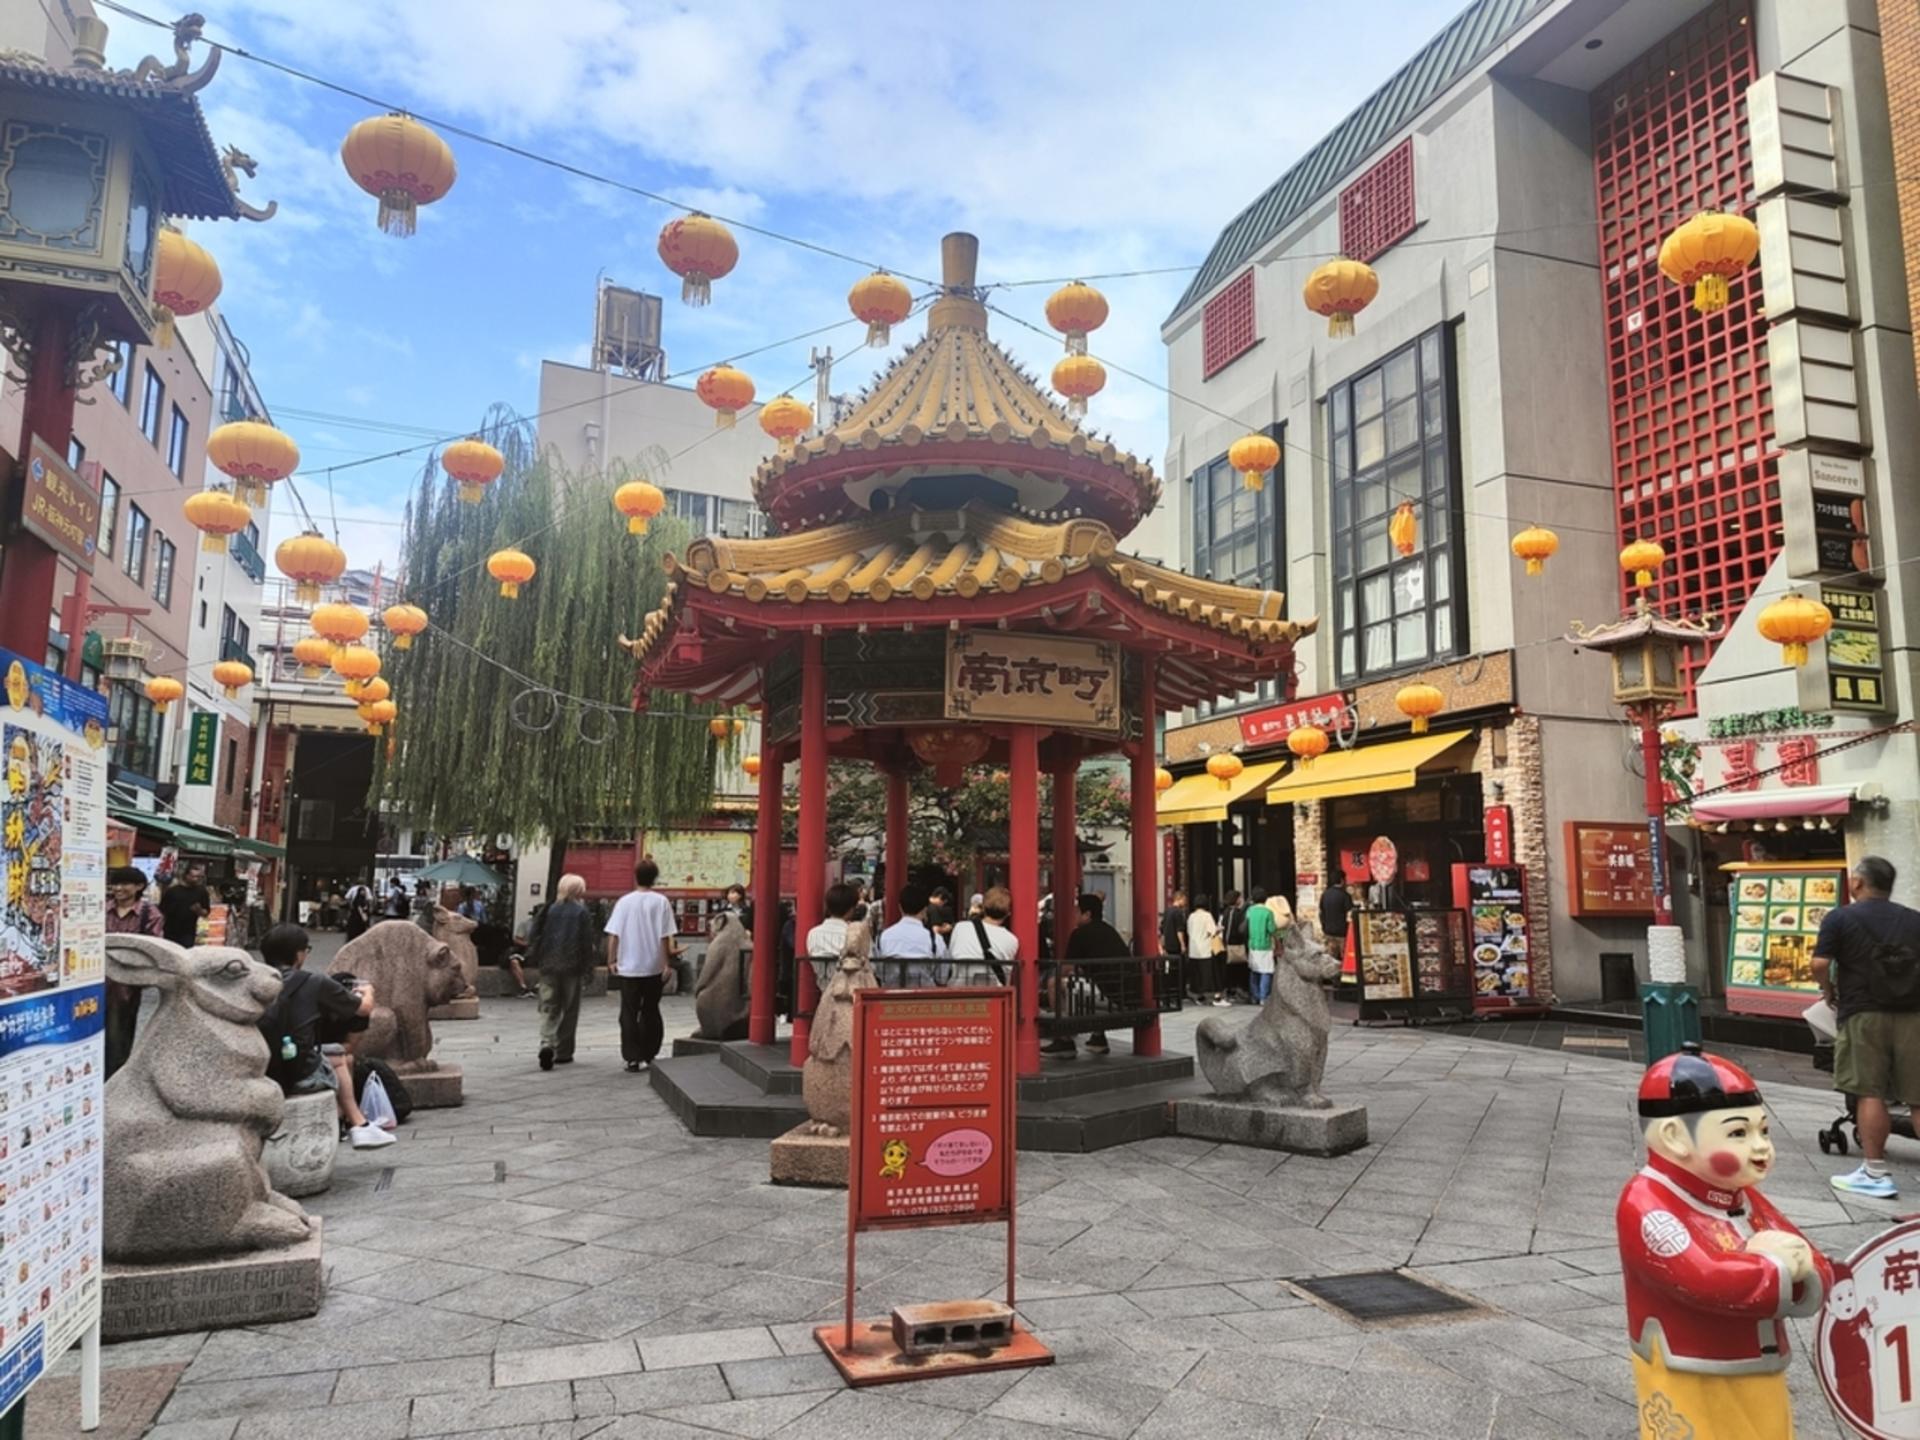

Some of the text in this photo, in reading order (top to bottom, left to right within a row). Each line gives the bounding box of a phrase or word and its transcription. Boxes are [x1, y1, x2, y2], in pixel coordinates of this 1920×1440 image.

[46, 469, 95, 523] 観光トイレ
[957, 651, 1110, 701] 南京町
[243, 1266, 302, 1290] FACTORY
[1883, 1323, 1913, 1403] 1
